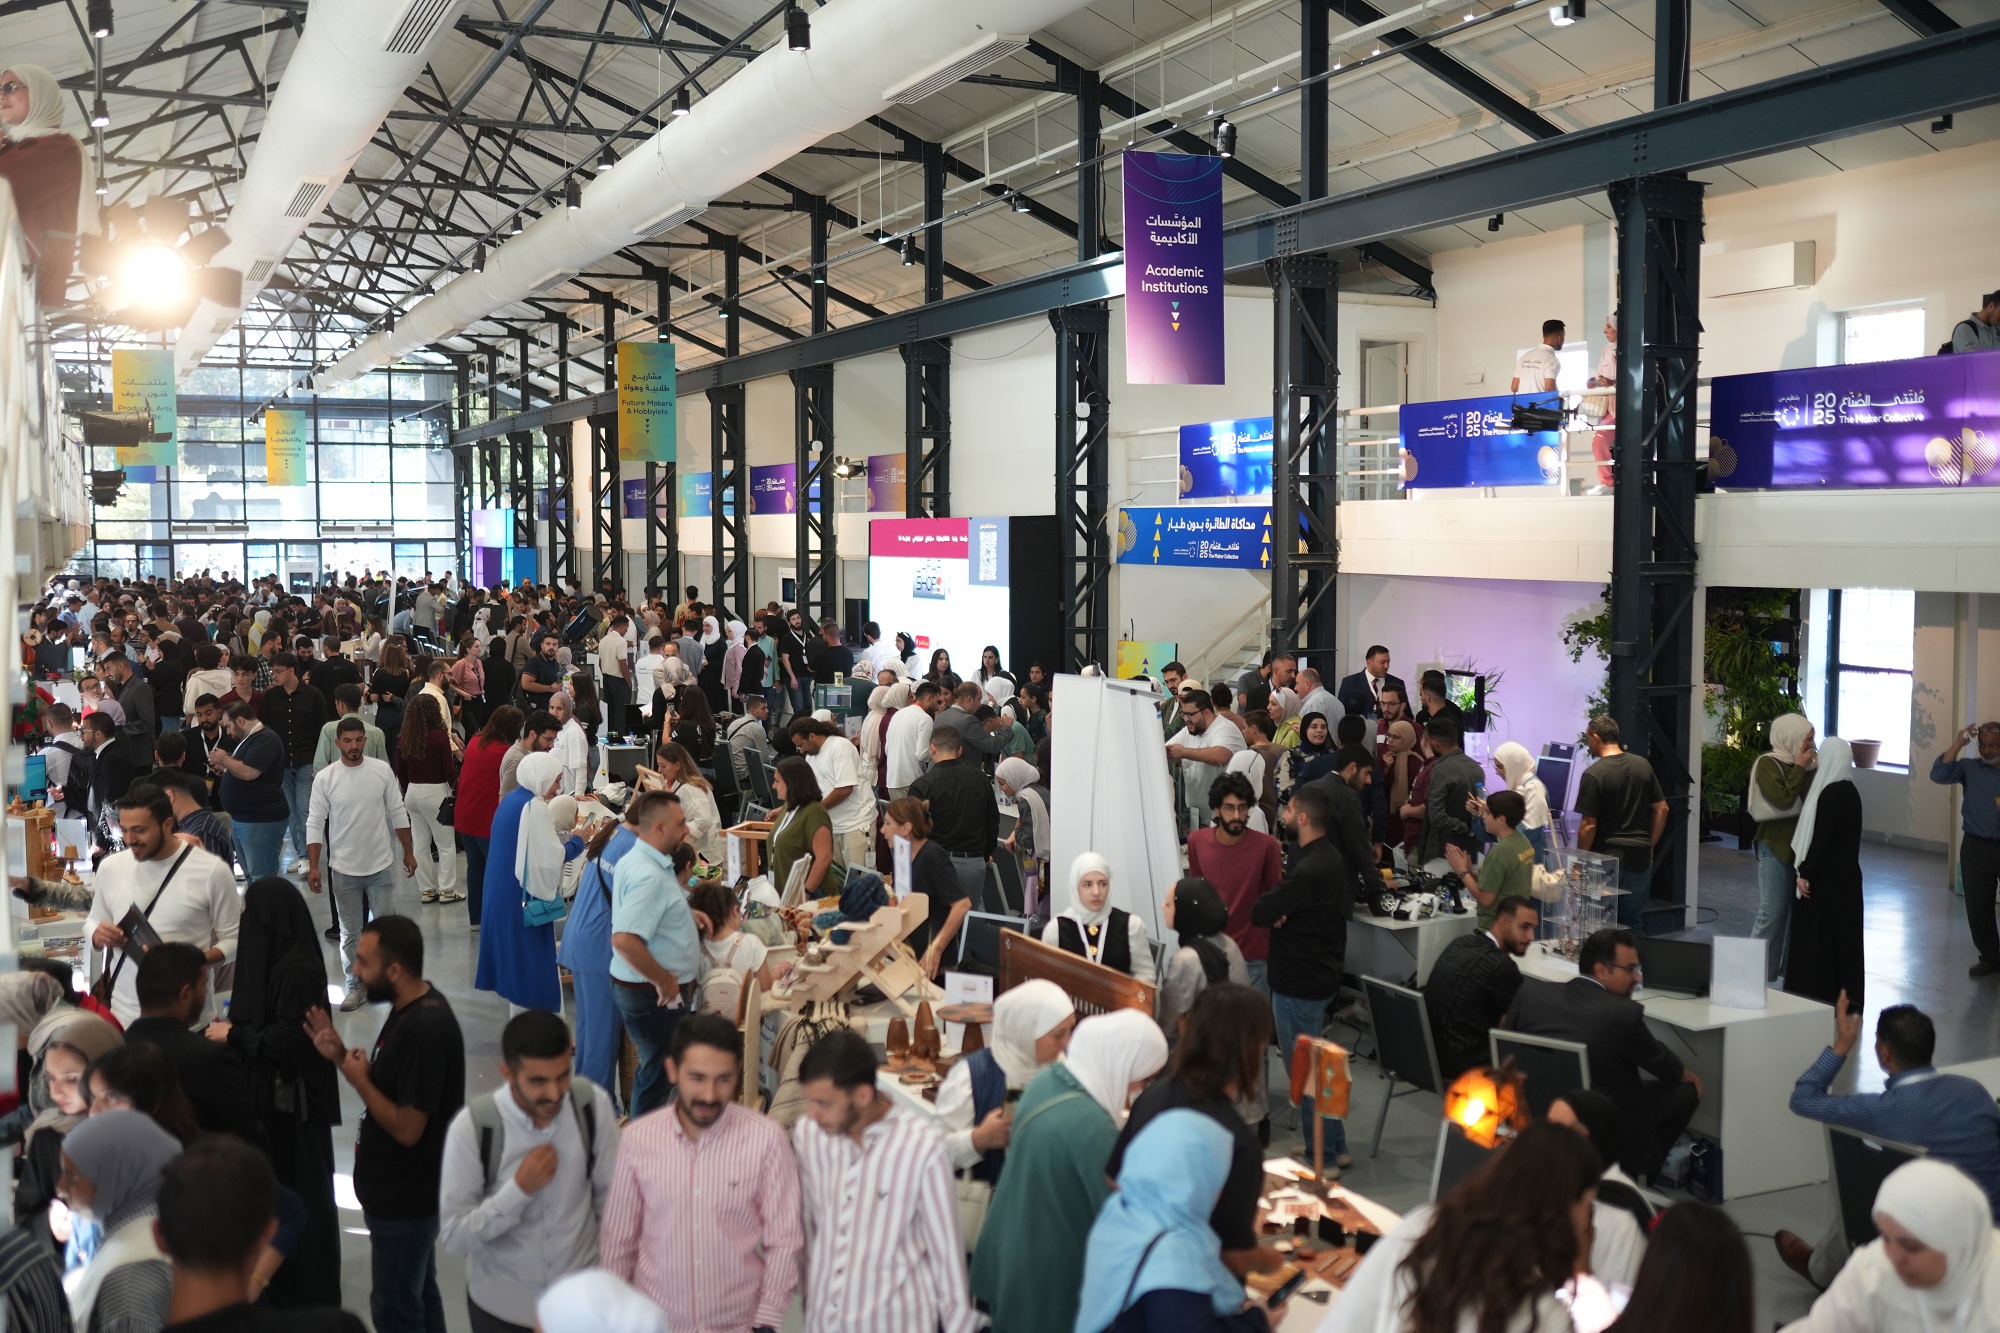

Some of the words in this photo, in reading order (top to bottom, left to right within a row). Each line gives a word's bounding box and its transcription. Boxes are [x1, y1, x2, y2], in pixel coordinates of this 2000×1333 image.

[1150, 232, 1198, 246] الأكاديمية
[1145, 264, 1204, 278] Academic
[1142, 280, 1208, 294] Institutions
[624, 384, 643, 392] وهواة
[646, 384, 670, 393] طلابية
[1814, 393, 1836, 408] 20
[1466, 411, 1480, 424] 20
[1813, 409, 1836, 425] 25
[1840, 416, 1854, 424] The
[1855, 413, 1882, 423] Maker
[1883, 412, 1924, 422] Collective
[1466, 425, 1480, 437] 25
[1167, 518, 1186, 532] طيار
[1187, 520, 1204, 532] بدون
[1205, 517, 1230, 532] الطائرة
[1231, 518, 1256, 530] محاكاة
[1200, 540, 1208, 549] 20
[1199, 550, 1208, 559] 25
